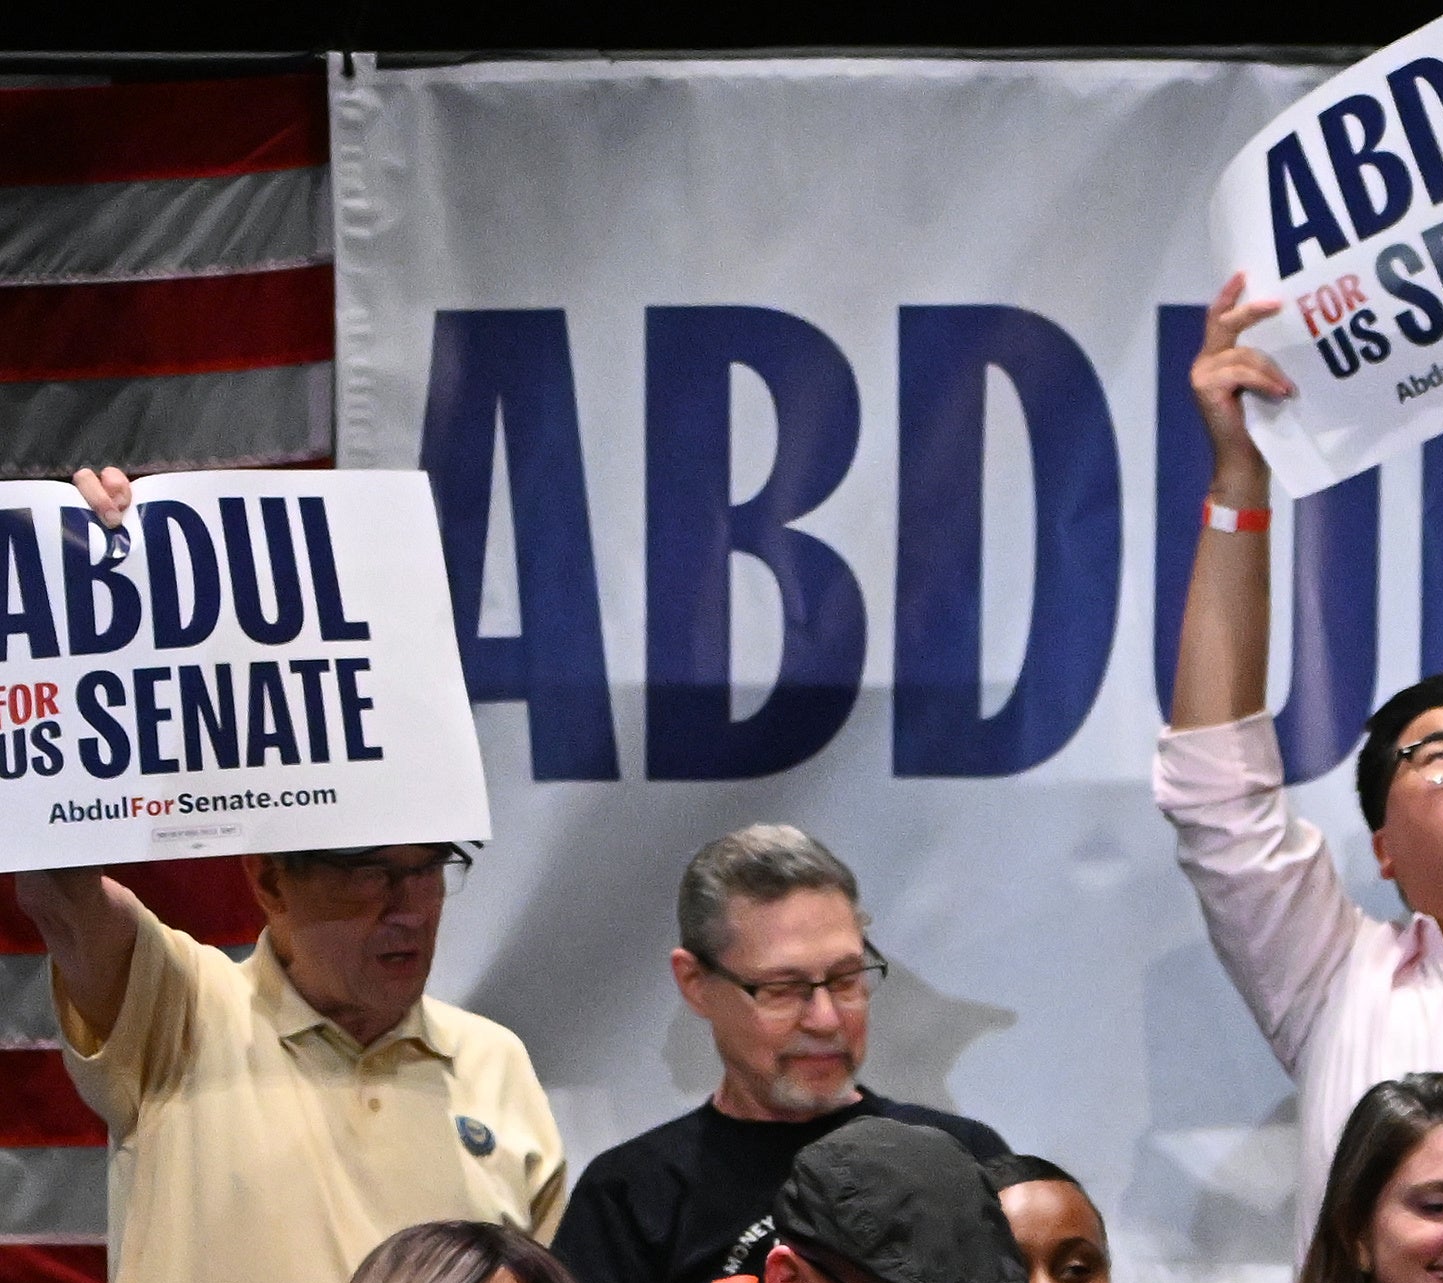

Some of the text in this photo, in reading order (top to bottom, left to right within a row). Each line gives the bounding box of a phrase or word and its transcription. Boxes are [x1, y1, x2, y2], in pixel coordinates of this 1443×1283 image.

[1297, 274, 1367, 338] FOR
[1315, 311, 1392, 380] US
[0, 496, 370, 662] ABDUL
[0, 682, 60, 730] FOR
[0, 658, 384, 780] US SENATE
[49, 784, 337, 824] AbdulForSenate.com
